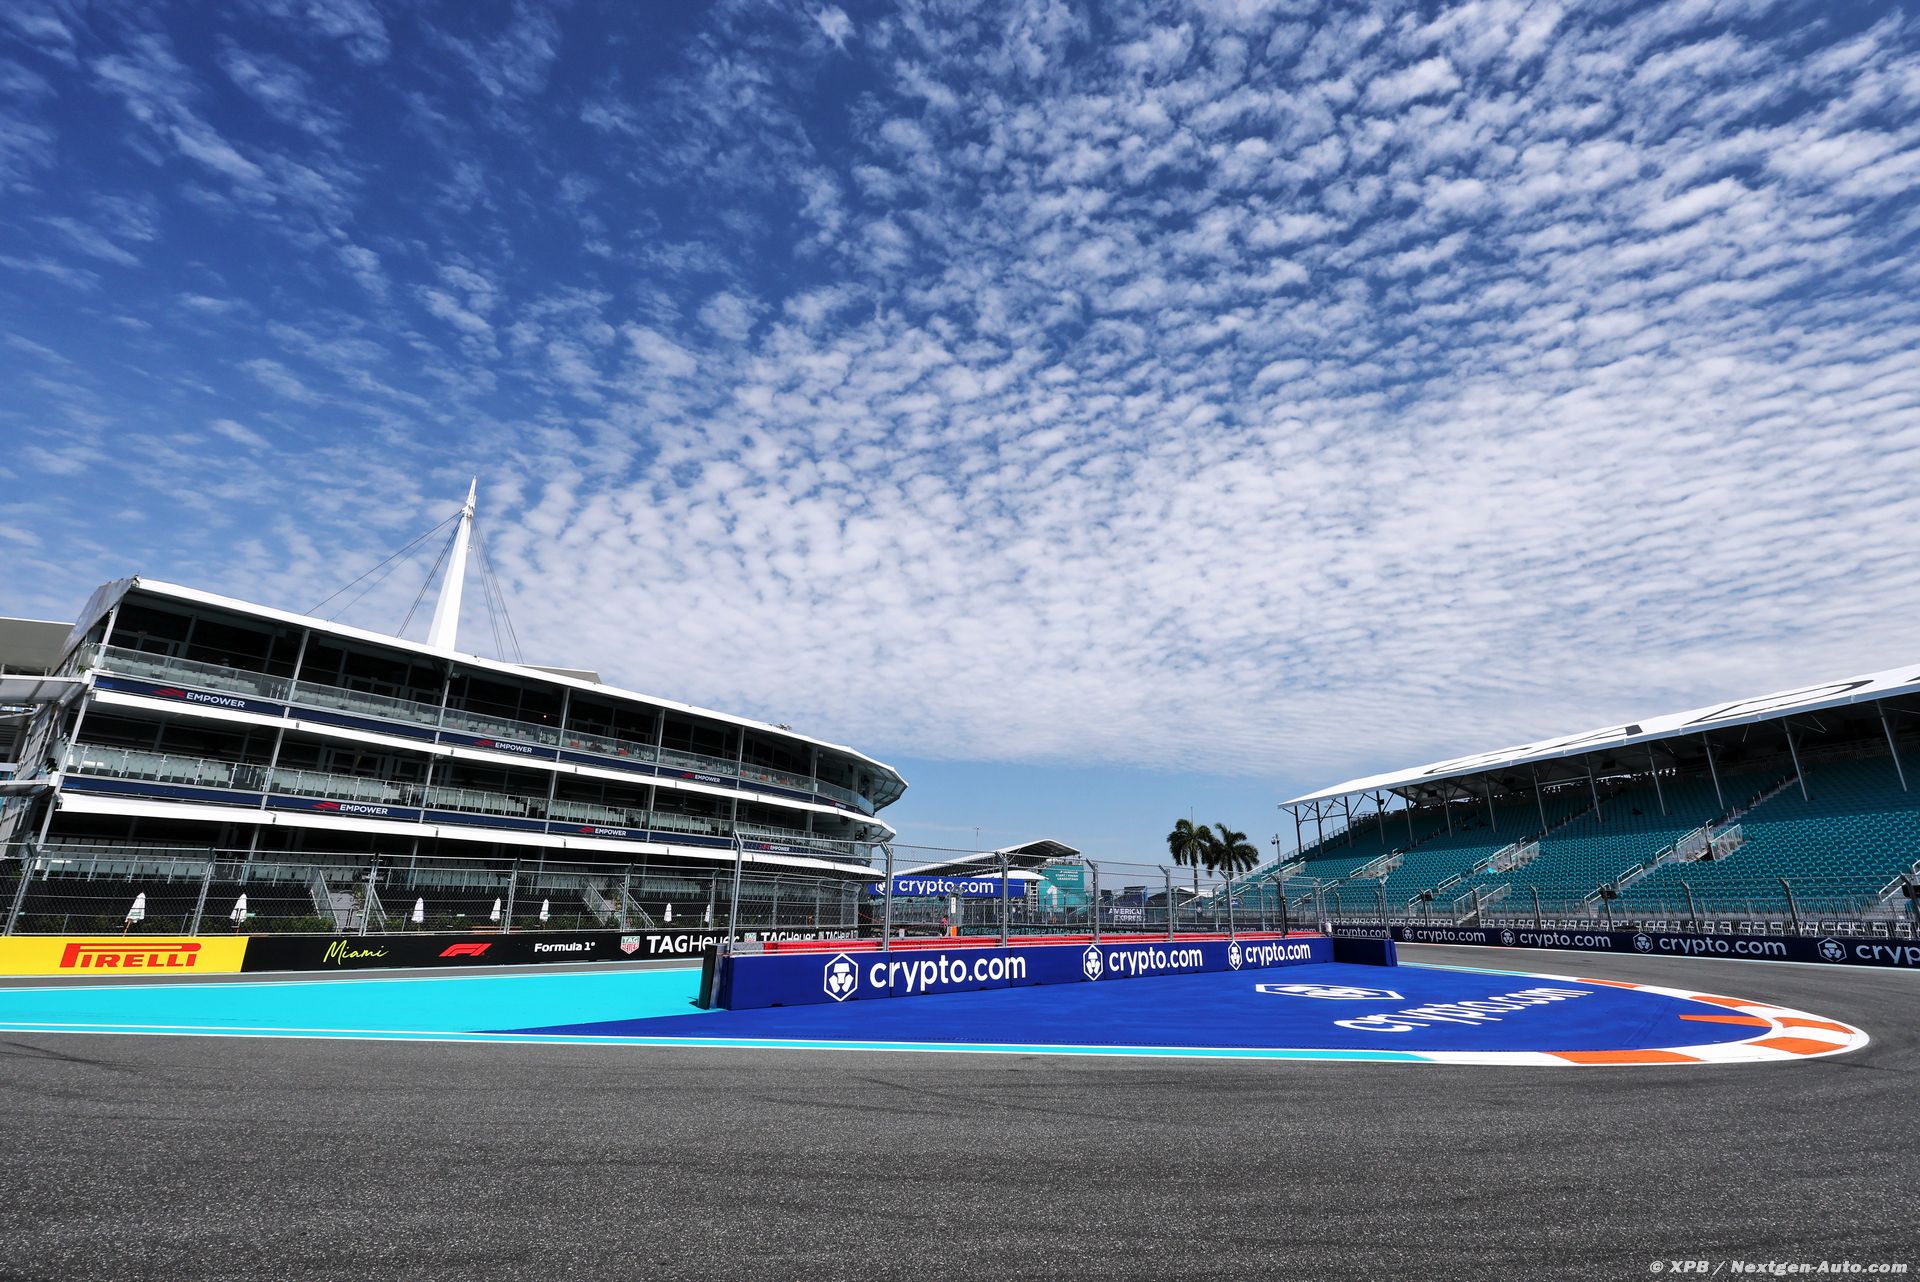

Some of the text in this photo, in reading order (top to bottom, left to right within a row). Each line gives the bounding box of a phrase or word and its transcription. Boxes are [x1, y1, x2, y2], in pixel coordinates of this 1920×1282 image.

[186, 692, 246, 709] EMPOWER
[494, 741, 533, 754] EMPOWER
[694, 773, 721, 783] EMPOWER
[339, 803, 388, 815] EMPOWER
[594, 827, 627, 837] EMPOWER
[898, 879, 994, 895] cryptocom
[1416, 928, 1486, 943] crypto.com
[1519, 931, 1612, 947] crypto.com
[322, 940, 389, 965] Miami
[534, 942, 583, 953] Formula
[1245, 943, 1312, 966] crypto.com
[1658, 936, 1788, 956] crypto.com
[59, 943, 202, 968] PIRELLI
[1108, 946, 1203, 976] crypto.com
[1855, 944, 1920, 969] cryp
[869, 954, 1026, 993] crypto.com
[1333, 987, 1595, 1033] crypto.com
